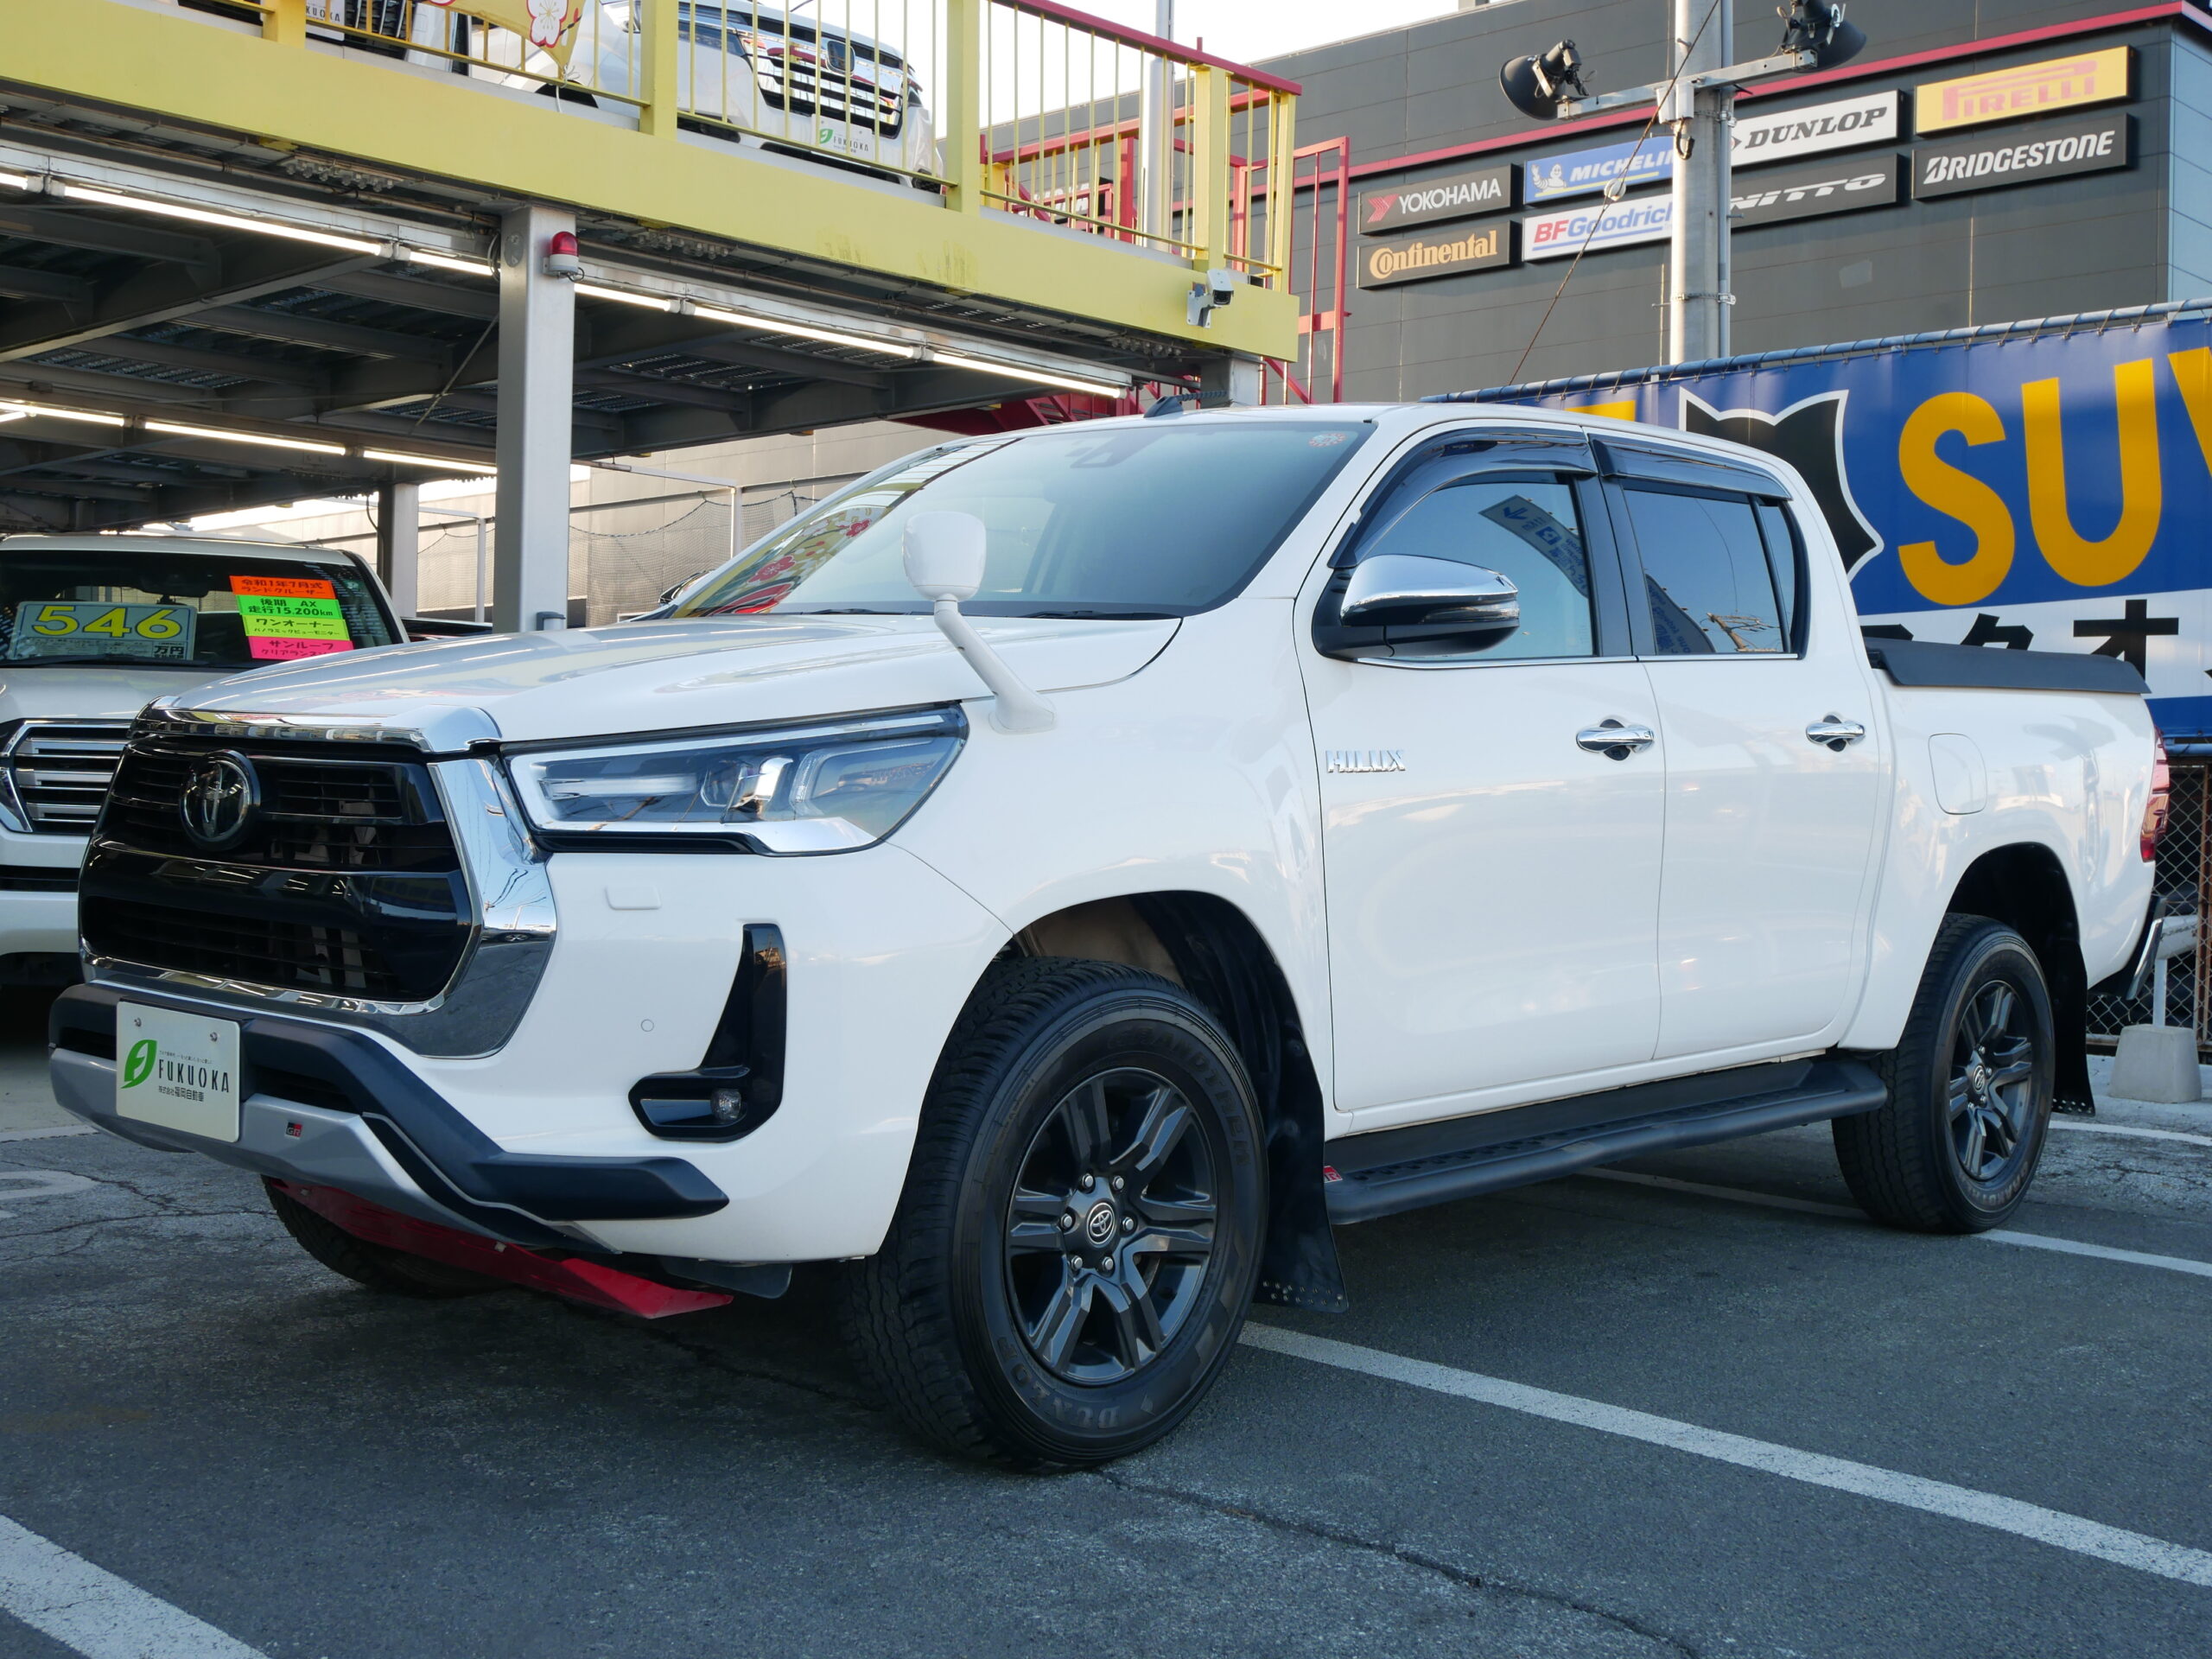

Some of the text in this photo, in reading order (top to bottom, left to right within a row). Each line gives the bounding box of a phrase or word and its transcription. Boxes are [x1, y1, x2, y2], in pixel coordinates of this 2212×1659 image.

[1942, 60, 2098, 121] PIRELLI
[1744, 106, 1888, 149] DUNLOP
[1923, 130, 2116, 184] BRIDGESTONE
[1398, 177, 1502, 215] YOKOHAMA
[1730, 173, 1886, 212] NITTO
[1369, 230, 1498, 279] Continental
[260, 598, 287, 607] 後期
[31, 605, 183, 639] 546
[256, 618, 335, 628] ワンオーナー
[153, 645, 184, 655] 万円
[269, 640, 334, 651] サンルーフ
[1325, 750, 1407, 773] HILUX
[158, 1058, 230, 1093] FUKUOKA
[287, 1126, 302, 1138] GR
